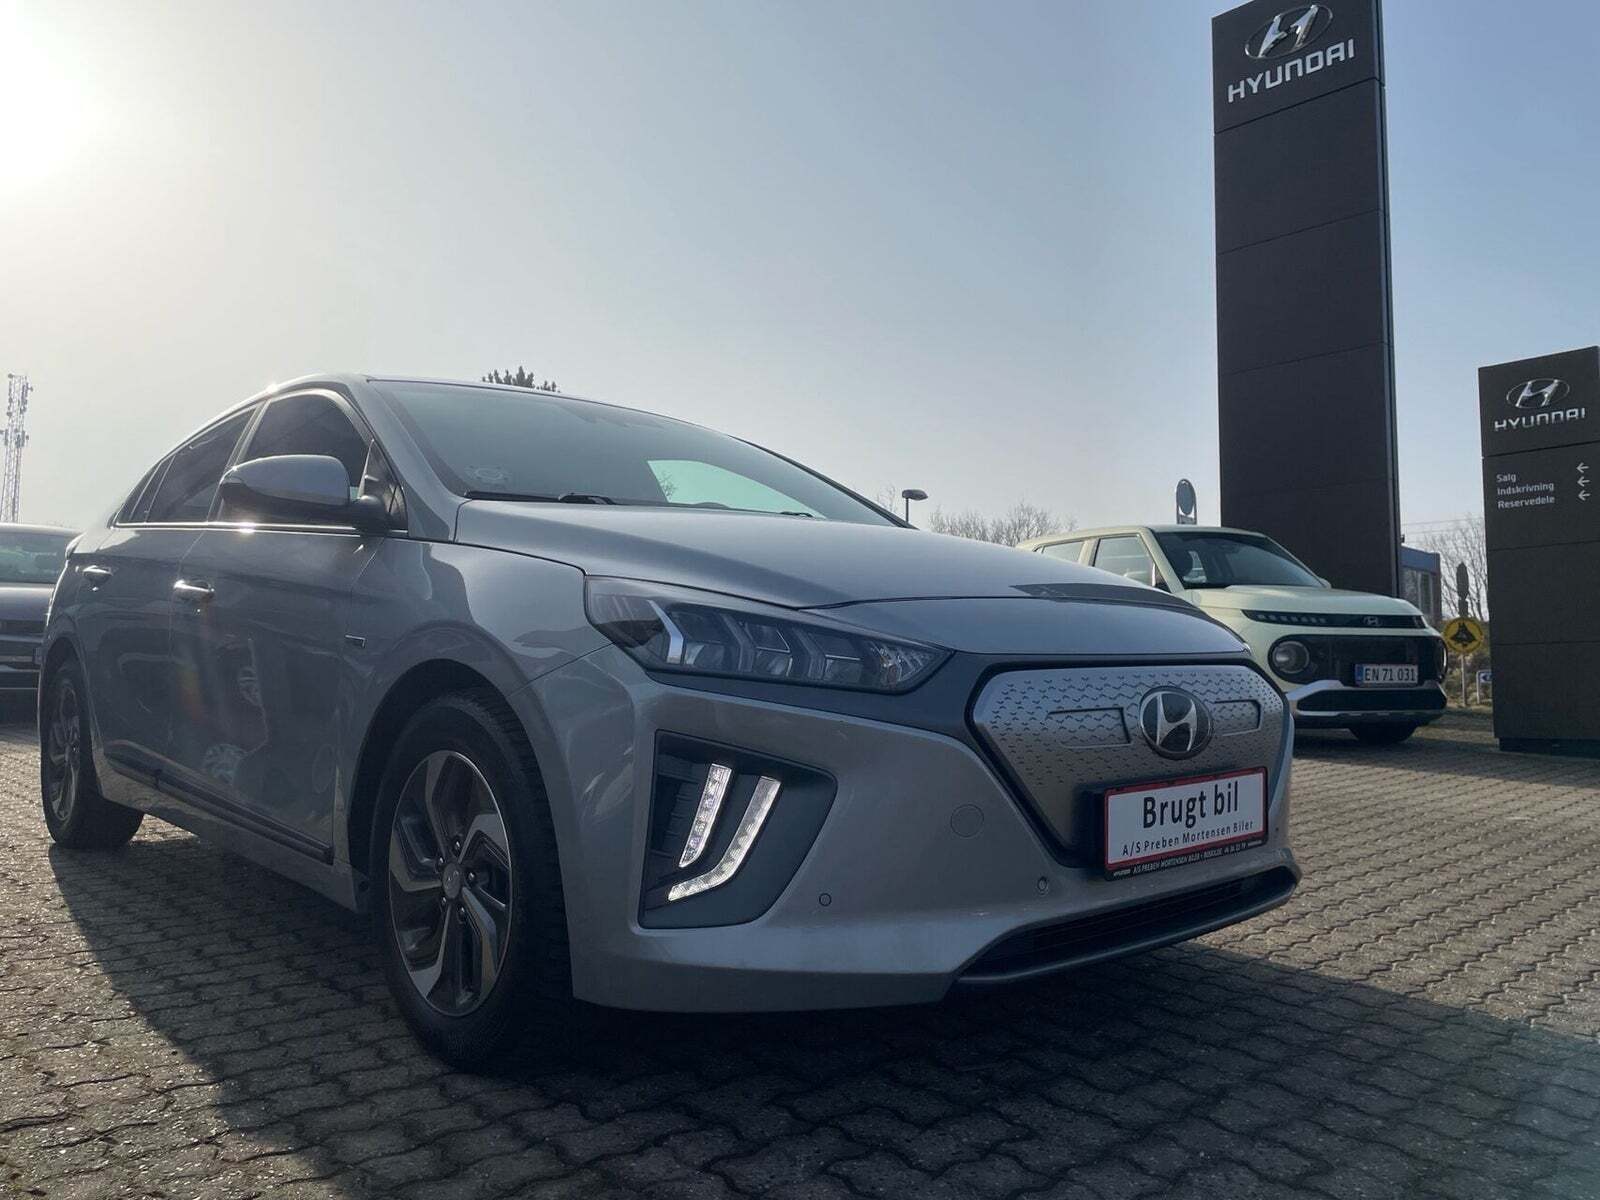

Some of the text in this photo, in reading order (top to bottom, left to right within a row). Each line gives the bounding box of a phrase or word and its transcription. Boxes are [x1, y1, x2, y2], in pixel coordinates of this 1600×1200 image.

[1227, 38, 1355, 103] HYUNDAI
[1494, 407, 1586, 431] HYUNDAI
[1496, 473, 1517, 483] Salg
[1497, 482, 1555, 496] Indskrivning
[1497, 495, 1556, 509] Reservedele
[1365, 667, 1416, 681] EN 71 031
[1143, 781, 1239, 829] Brugt bil
[1122, 821, 1254, 857] A/S Preben Mortensen Biler
